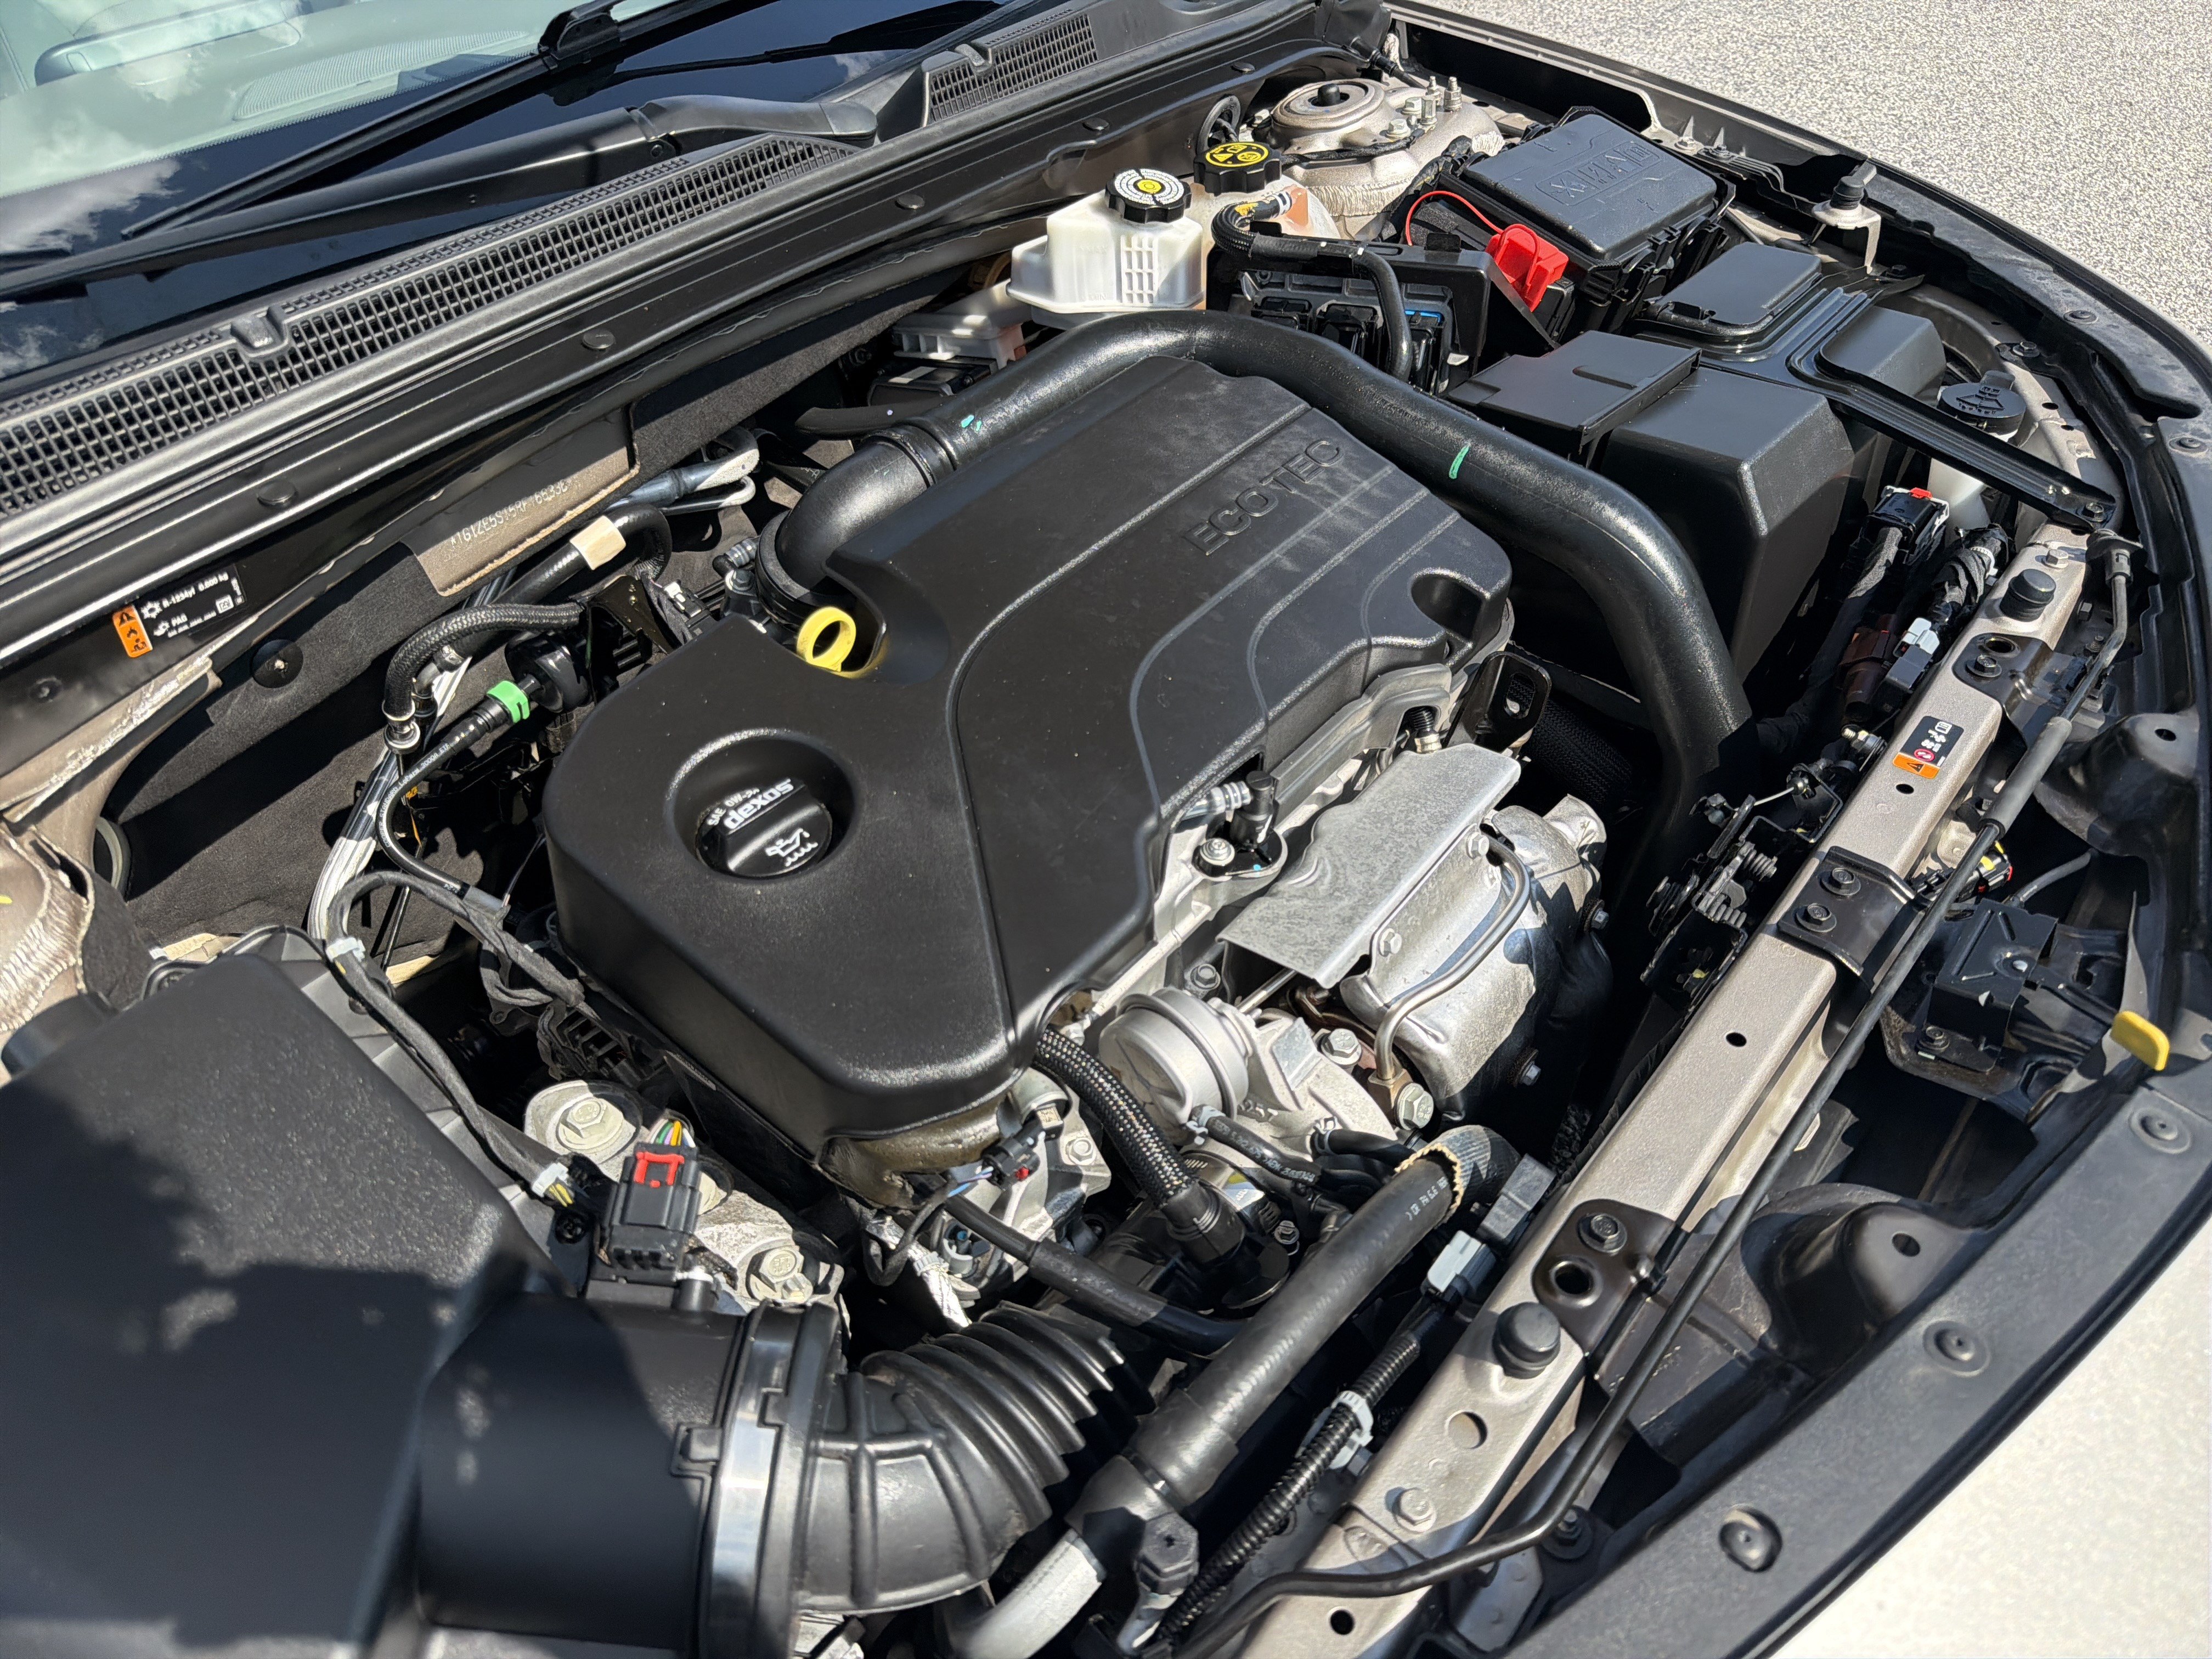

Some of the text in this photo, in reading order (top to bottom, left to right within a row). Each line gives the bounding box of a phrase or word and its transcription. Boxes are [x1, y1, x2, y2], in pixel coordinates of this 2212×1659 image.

[1181, 439, 1342, 556] ECOTEC
[171, 613, 188, 627] PAG
[707, 808, 727, 826] SAE
[724, 778, 794, 830] dexos
